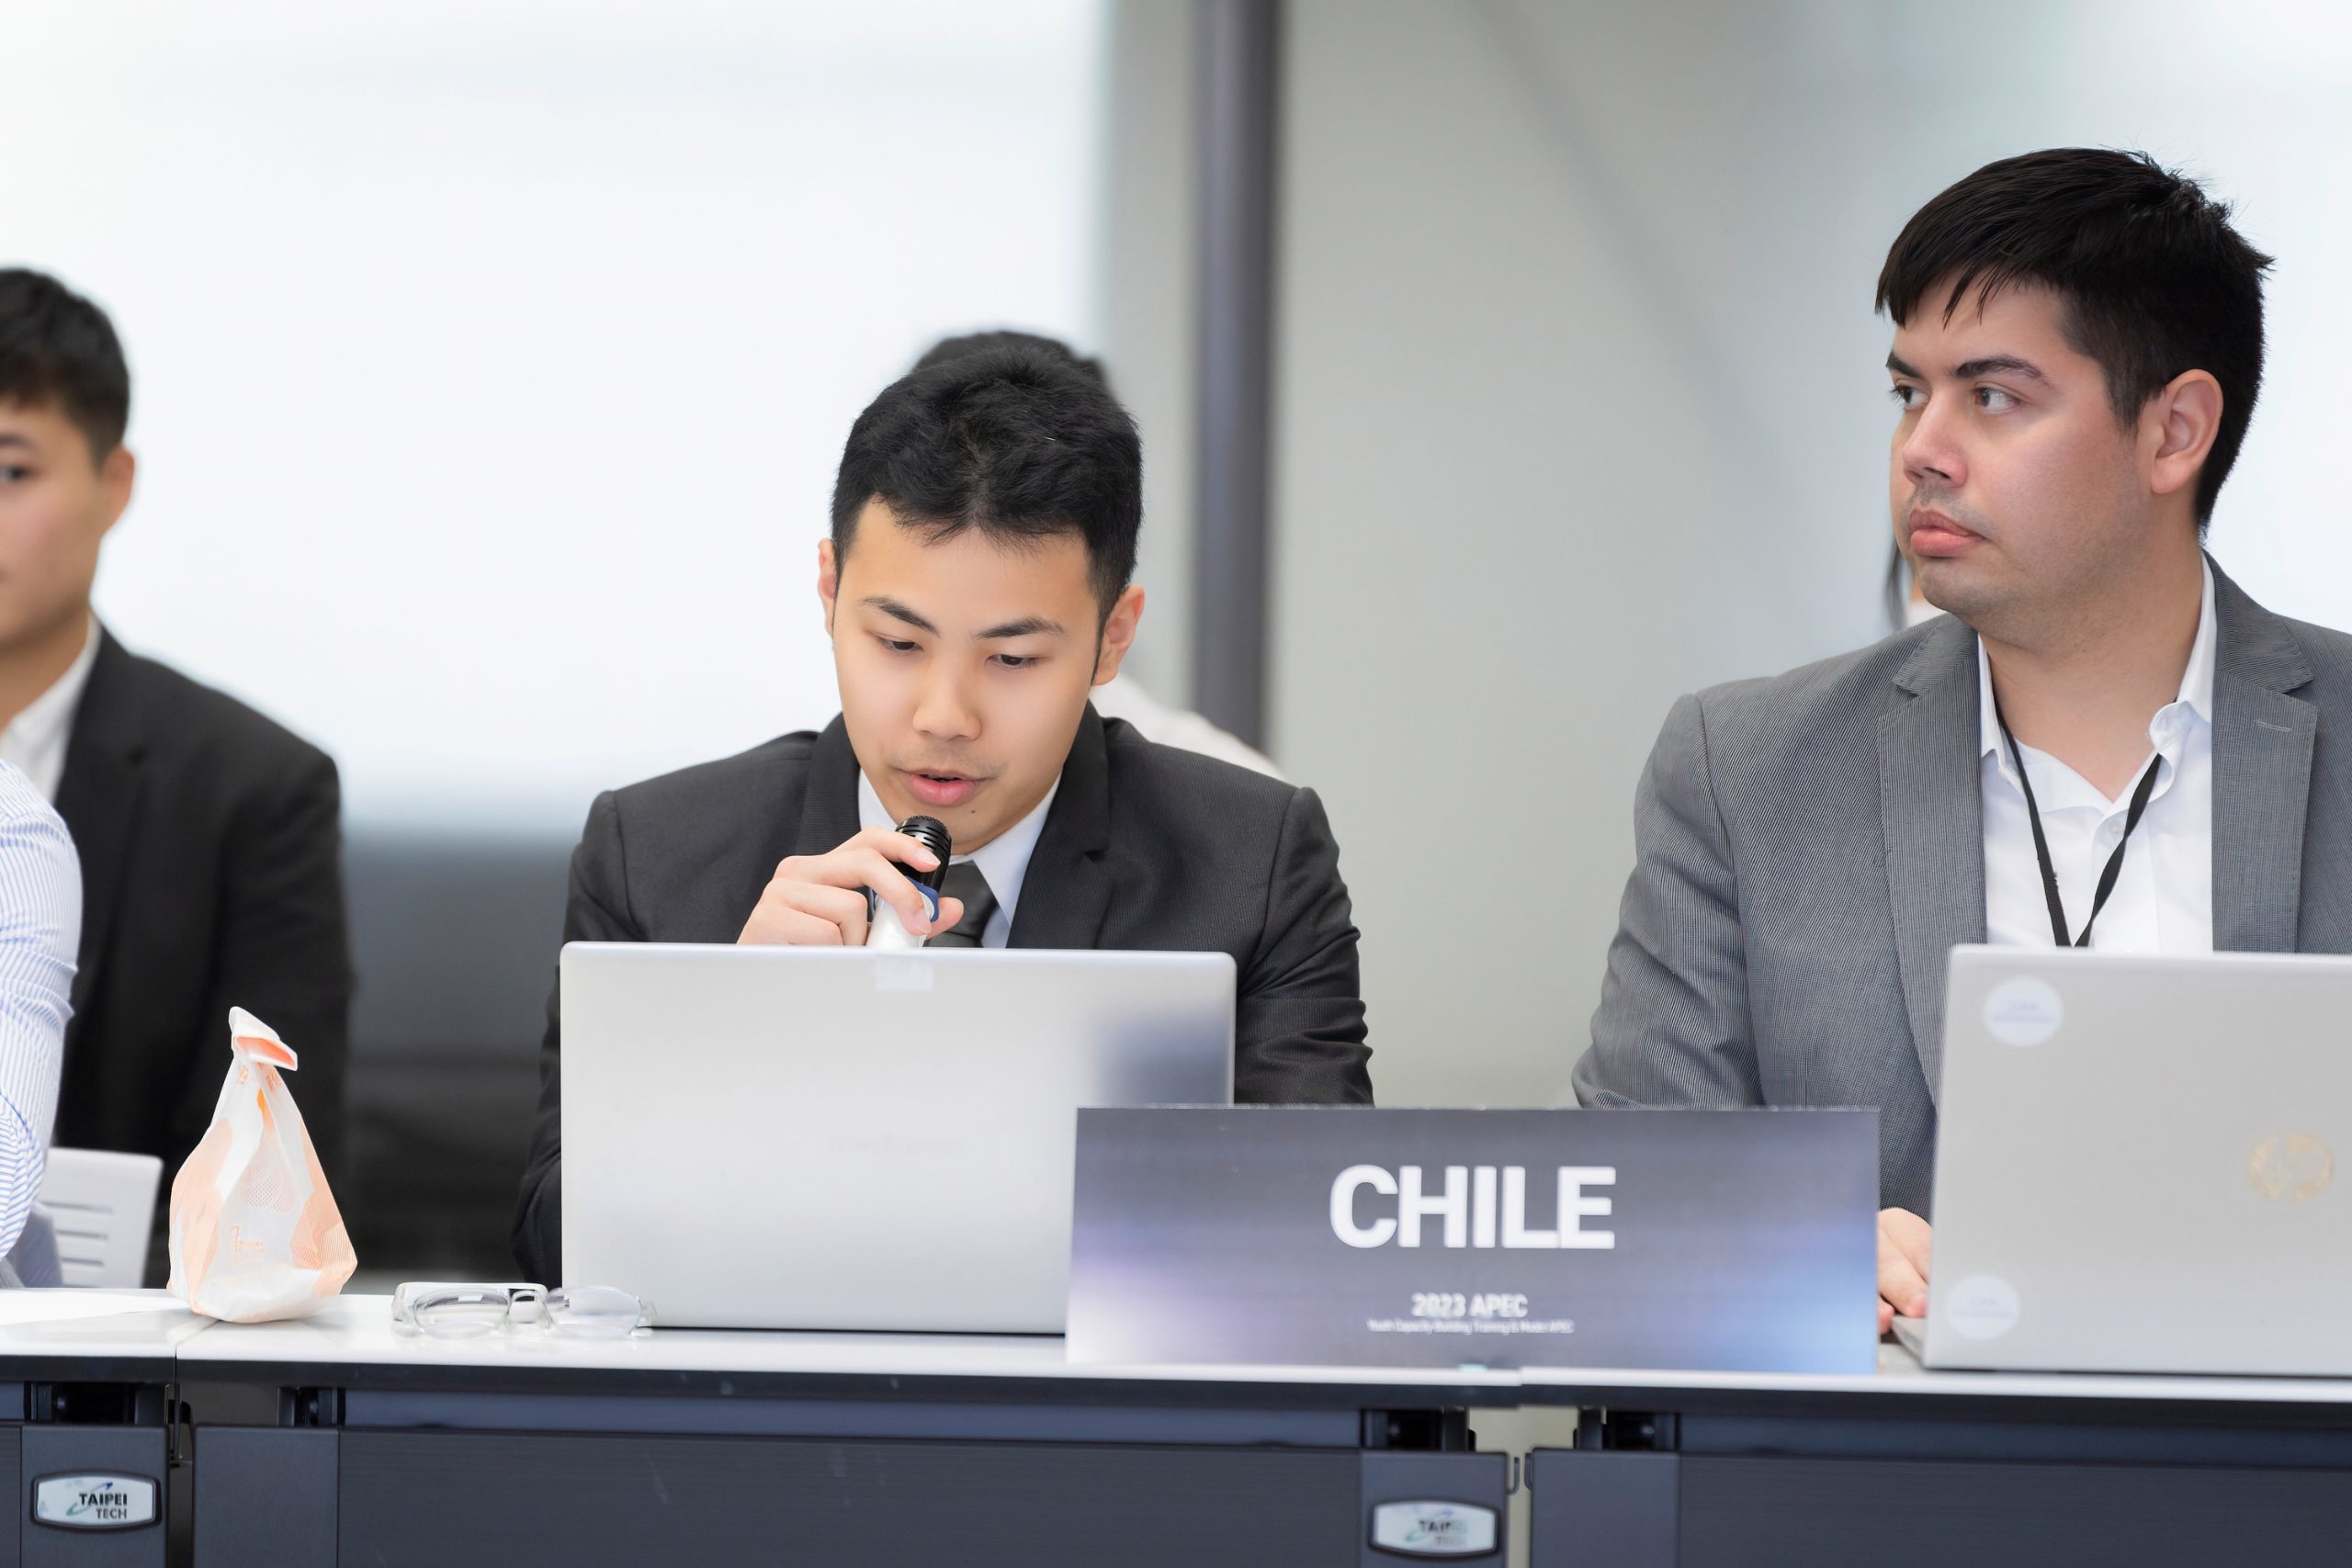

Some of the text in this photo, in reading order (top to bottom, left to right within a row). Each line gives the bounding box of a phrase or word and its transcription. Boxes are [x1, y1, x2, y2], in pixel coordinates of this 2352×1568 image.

[1329, 1164, 1616, 1249] CHILE
[1411, 1292, 1529, 1318] 2023 APEC
[80, 1493, 128, 1506] TAIPEI
[95, 1508, 127, 1519] TECH
